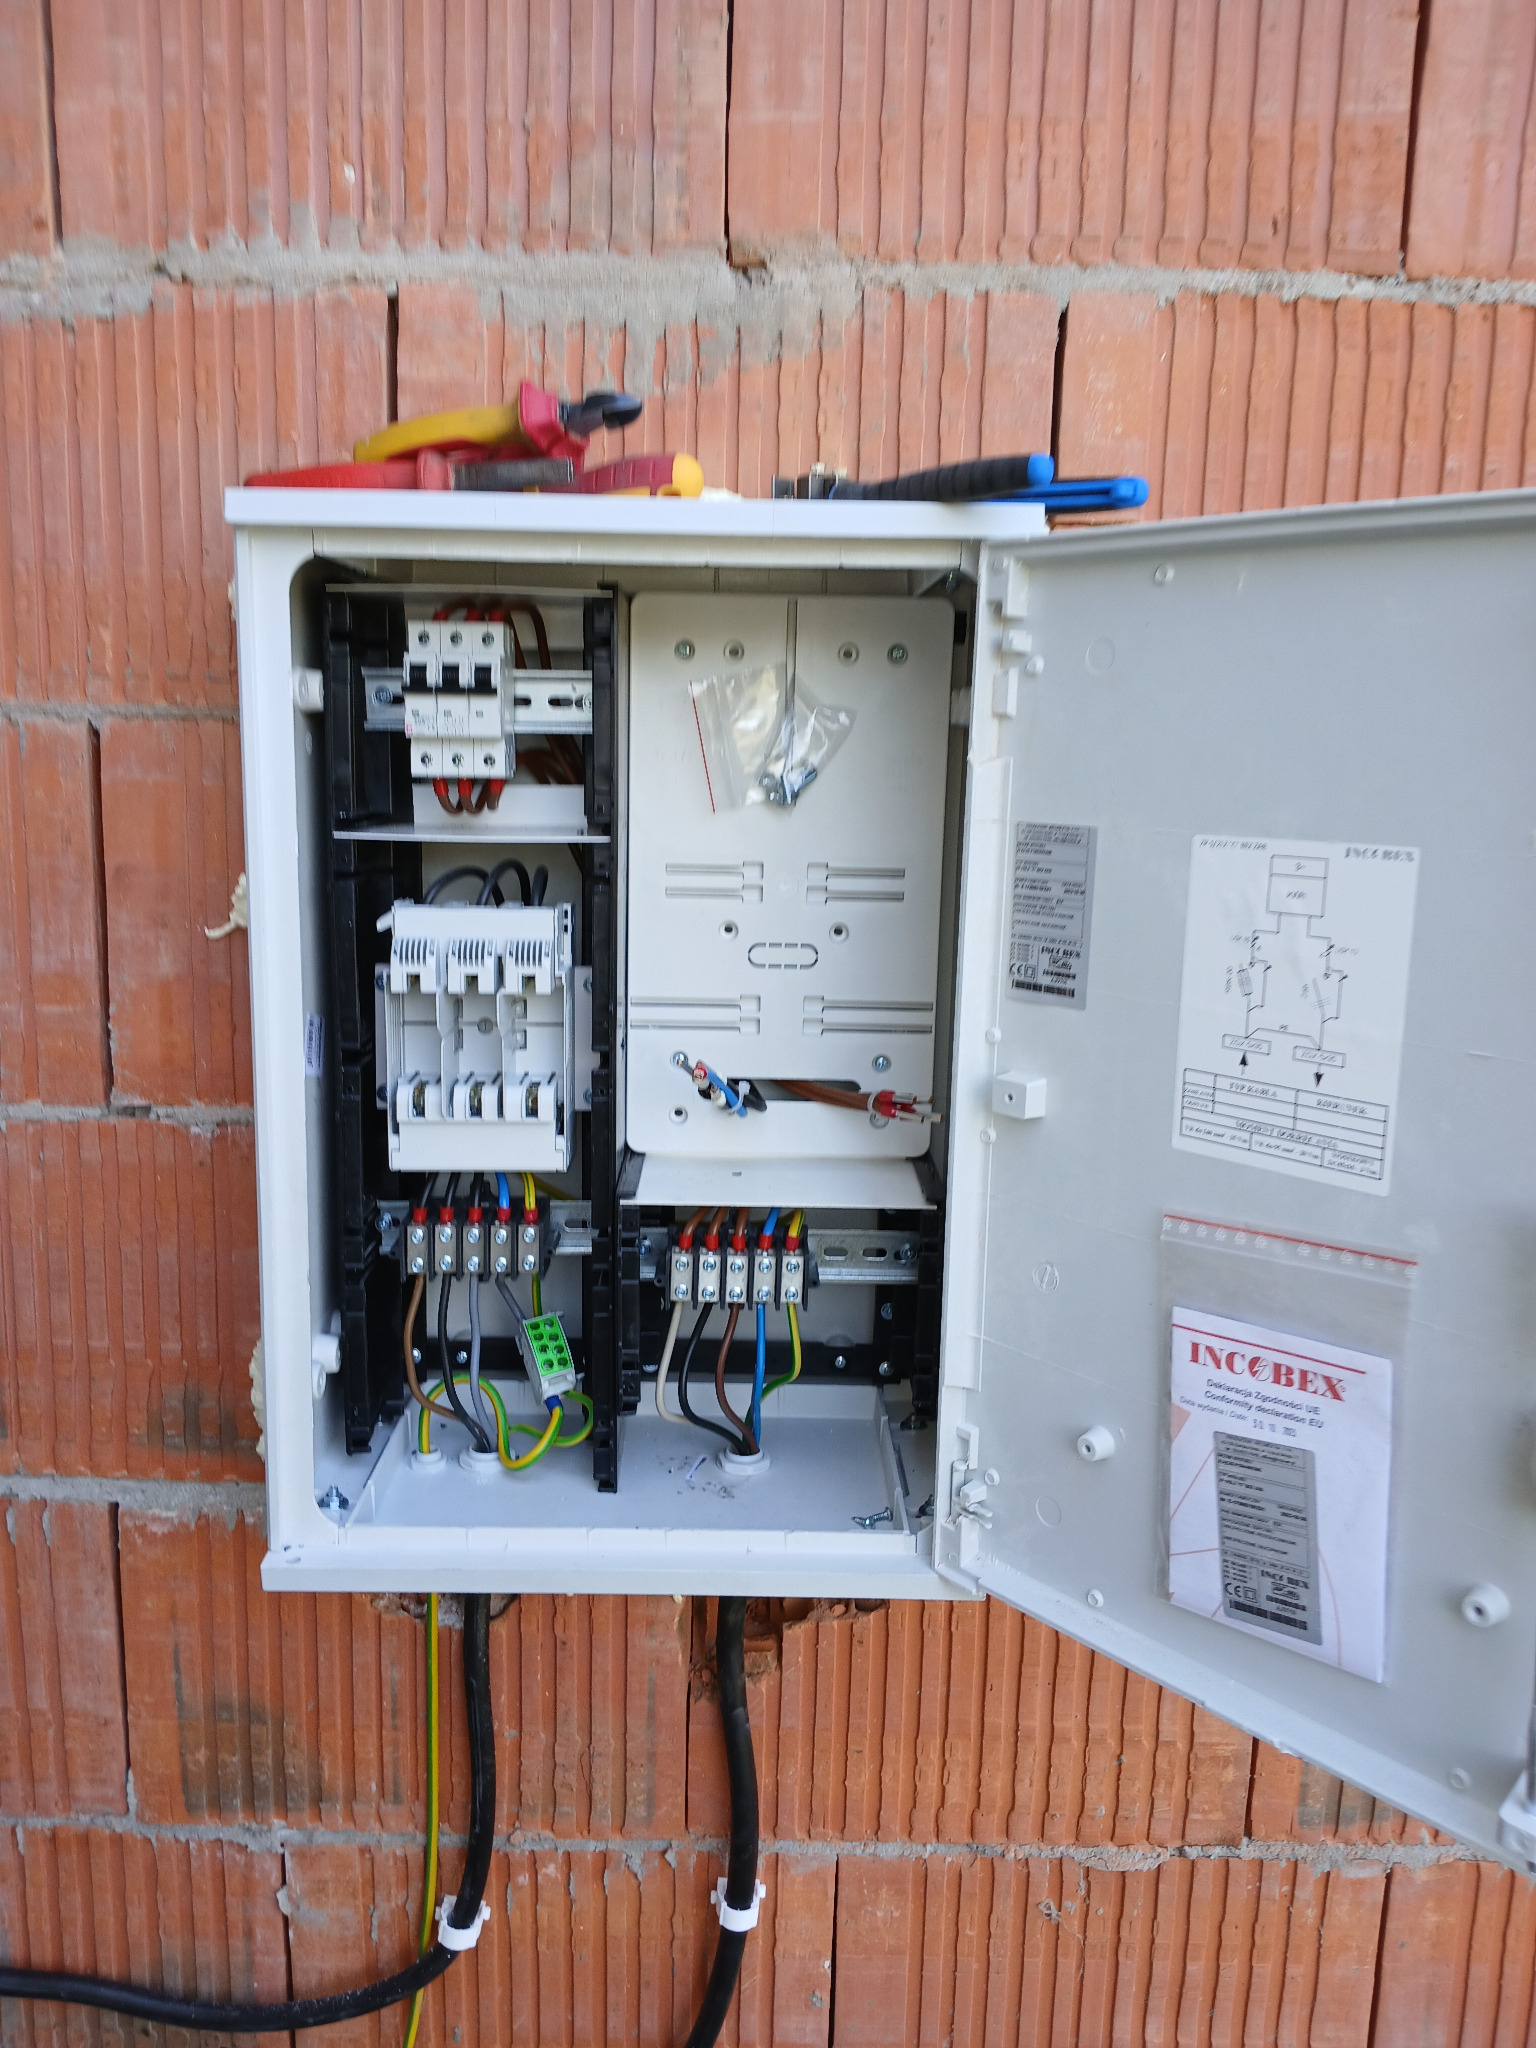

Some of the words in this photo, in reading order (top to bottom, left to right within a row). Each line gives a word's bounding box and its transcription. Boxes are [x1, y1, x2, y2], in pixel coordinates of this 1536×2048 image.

[1189, 1341, 1346, 1402] INCOBEX
[1204, 1390, 1253, 1411] Conformity
[1255, 1404, 1306, 1425] declaration
[1308, 1418, 1325, 1429] EU
[1206, 1379, 1253, 1399] Deklaracja
[1305, 1404, 1321, 1415] UE
